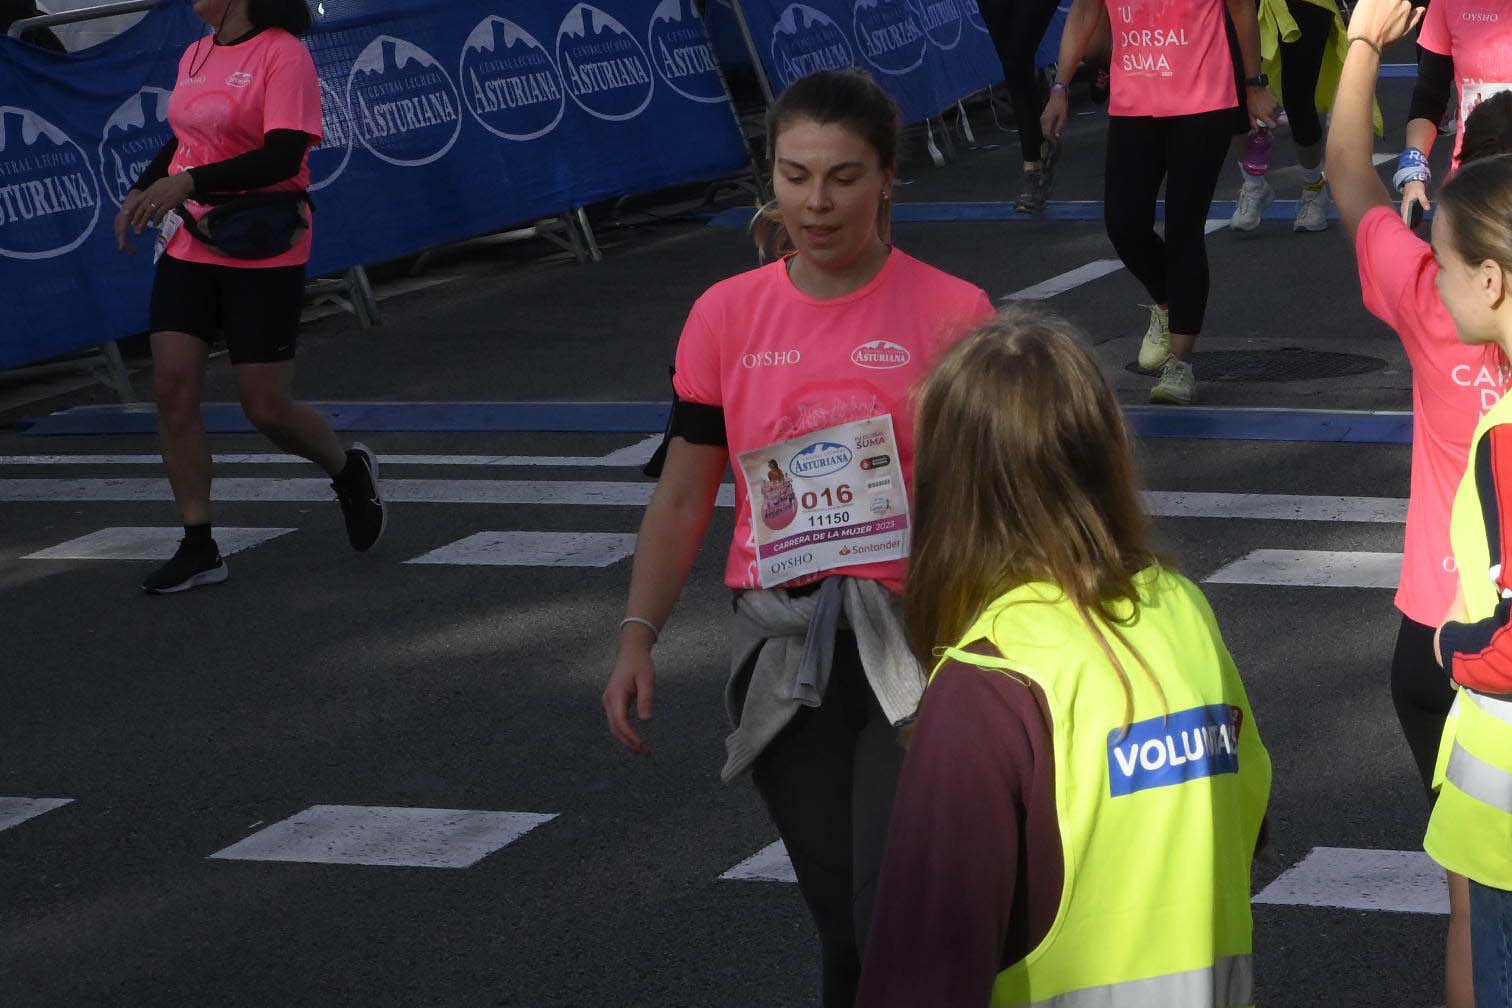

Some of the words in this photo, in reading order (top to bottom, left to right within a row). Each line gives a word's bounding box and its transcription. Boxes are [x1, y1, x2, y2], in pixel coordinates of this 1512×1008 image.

[1462, 11, 1498, 23] OYSHO
[564, 50, 650, 96] ASTURIANA
[1123, 53, 1170, 72] SUMA
[470, 66, 561, 115] ASTURIANA
[358, 90, 457, 140] ASTURIANA
[742, 349, 801, 369] OYSHO
[856, 436, 886, 450] SUMA
[794, 453, 849, 474] ASTURIANA
[801, 483, 854, 510] 016
[808, 511, 850, 528] 11150
[773, 535, 811, 552] CARRERA
[812, 532, 825, 542] DE
[827, 530, 840, 540] LA
[841, 525, 873, 537] MUJER
[875, 519, 895, 532] 2023
[771, 553, 813, 574] OYSHO
[852, 539, 902, 555] Santander
